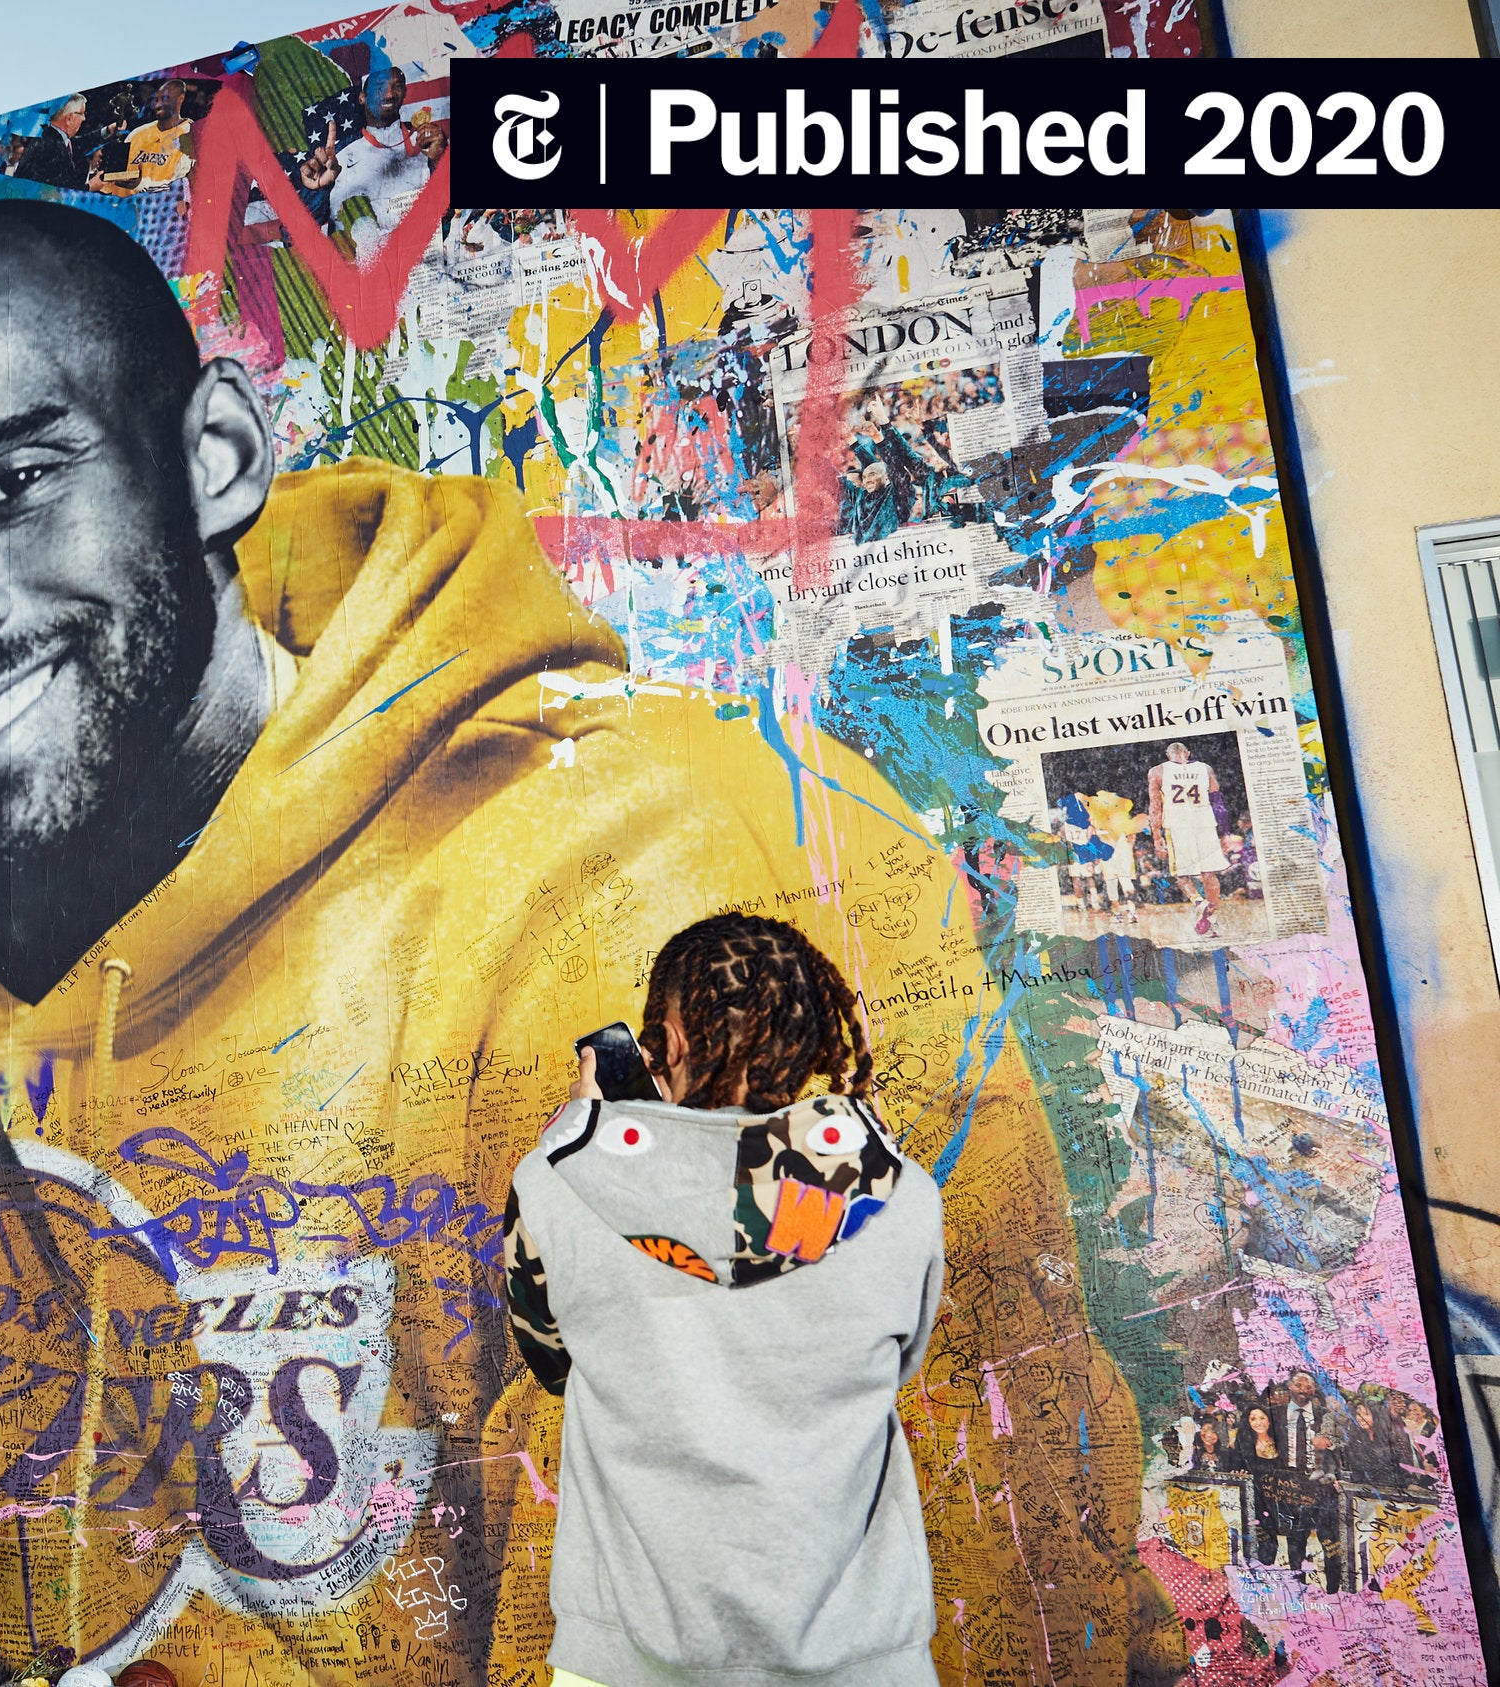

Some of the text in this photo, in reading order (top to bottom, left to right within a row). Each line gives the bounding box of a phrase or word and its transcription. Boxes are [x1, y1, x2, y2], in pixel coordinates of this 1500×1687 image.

[553, 0, 782, 46] LEGACY COMPLE
[1069, 15, 1104, 33] TITLE
[457, 260, 503, 276] KINGS OF
[475, 266, 511, 280] COURT
[994, 314, 1025, 333] and
[781, 307, 974, 373] LONDON
[873, 346, 943, 369] SUMMER
[853, 546, 888, 568] and
[893, 539, 954, 561] shine,
[787, 561, 968, 605] Bryant close it out
[1061, 693, 1118, 709] ANNOUNCES
[1120, 691, 1133, 702] HE
[1134, 688, 1160, 699] WILL
[1227, 675, 1265, 687] SEASON
[986, 691, 1288, 747] One last walk-off win
[1171, 784, 1202, 805] 24
[880, 837, 907, 861] LOVE
[719, 896, 766, 916] MAMBA
[859, 891, 914, 914] RIP KOBE
[57, 968, 81, 995] RIP
[82, 936, 112, 968] KOBE
[1319, 982, 1343, 998] RIP
[1147, 1034, 1195, 1061] Bryant
[1197, 1046, 1229, 1067] gets
[1231, 1053, 1277, 1077] Oscar
[447, 1067, 499, 1087] LOVE
[500, 1055, 540, 1083] YOU!
[403, 1091, 457, 1109] Thanks Kobe
[1239, 1076, 1309, 1106] animated
[224, 1116, 340, 1146] BALL IN HEAVEN
[481, 1129, 509, 1142] MAMBA
[259, 1141, 283, 1154] THE
[287, 1135, 337, 1151] GOAT
[3, 1439, 26, 1452] GOAT
[318, 1542, 368, 1581] LEGENDARY
[1373, 1563, 1403, 1577] KOBE
[279, 1597, 298, 1607] good
[385, 1583, 468, 1611] KING
[260, 1609, 284, 1620] enjoy
[286, 1608, 299, 1618] life
[301, 1607, 319, 1619] Life
[258, 1621, 282, 1631] short
[285, 1620, 295, 1629] to
[299, 1619, 314, 1632] get
[306, 1632, 329, 1642] down
[141, 1642, 202, 1659] FOREVER
[280, 1646, 295, 1658] get
